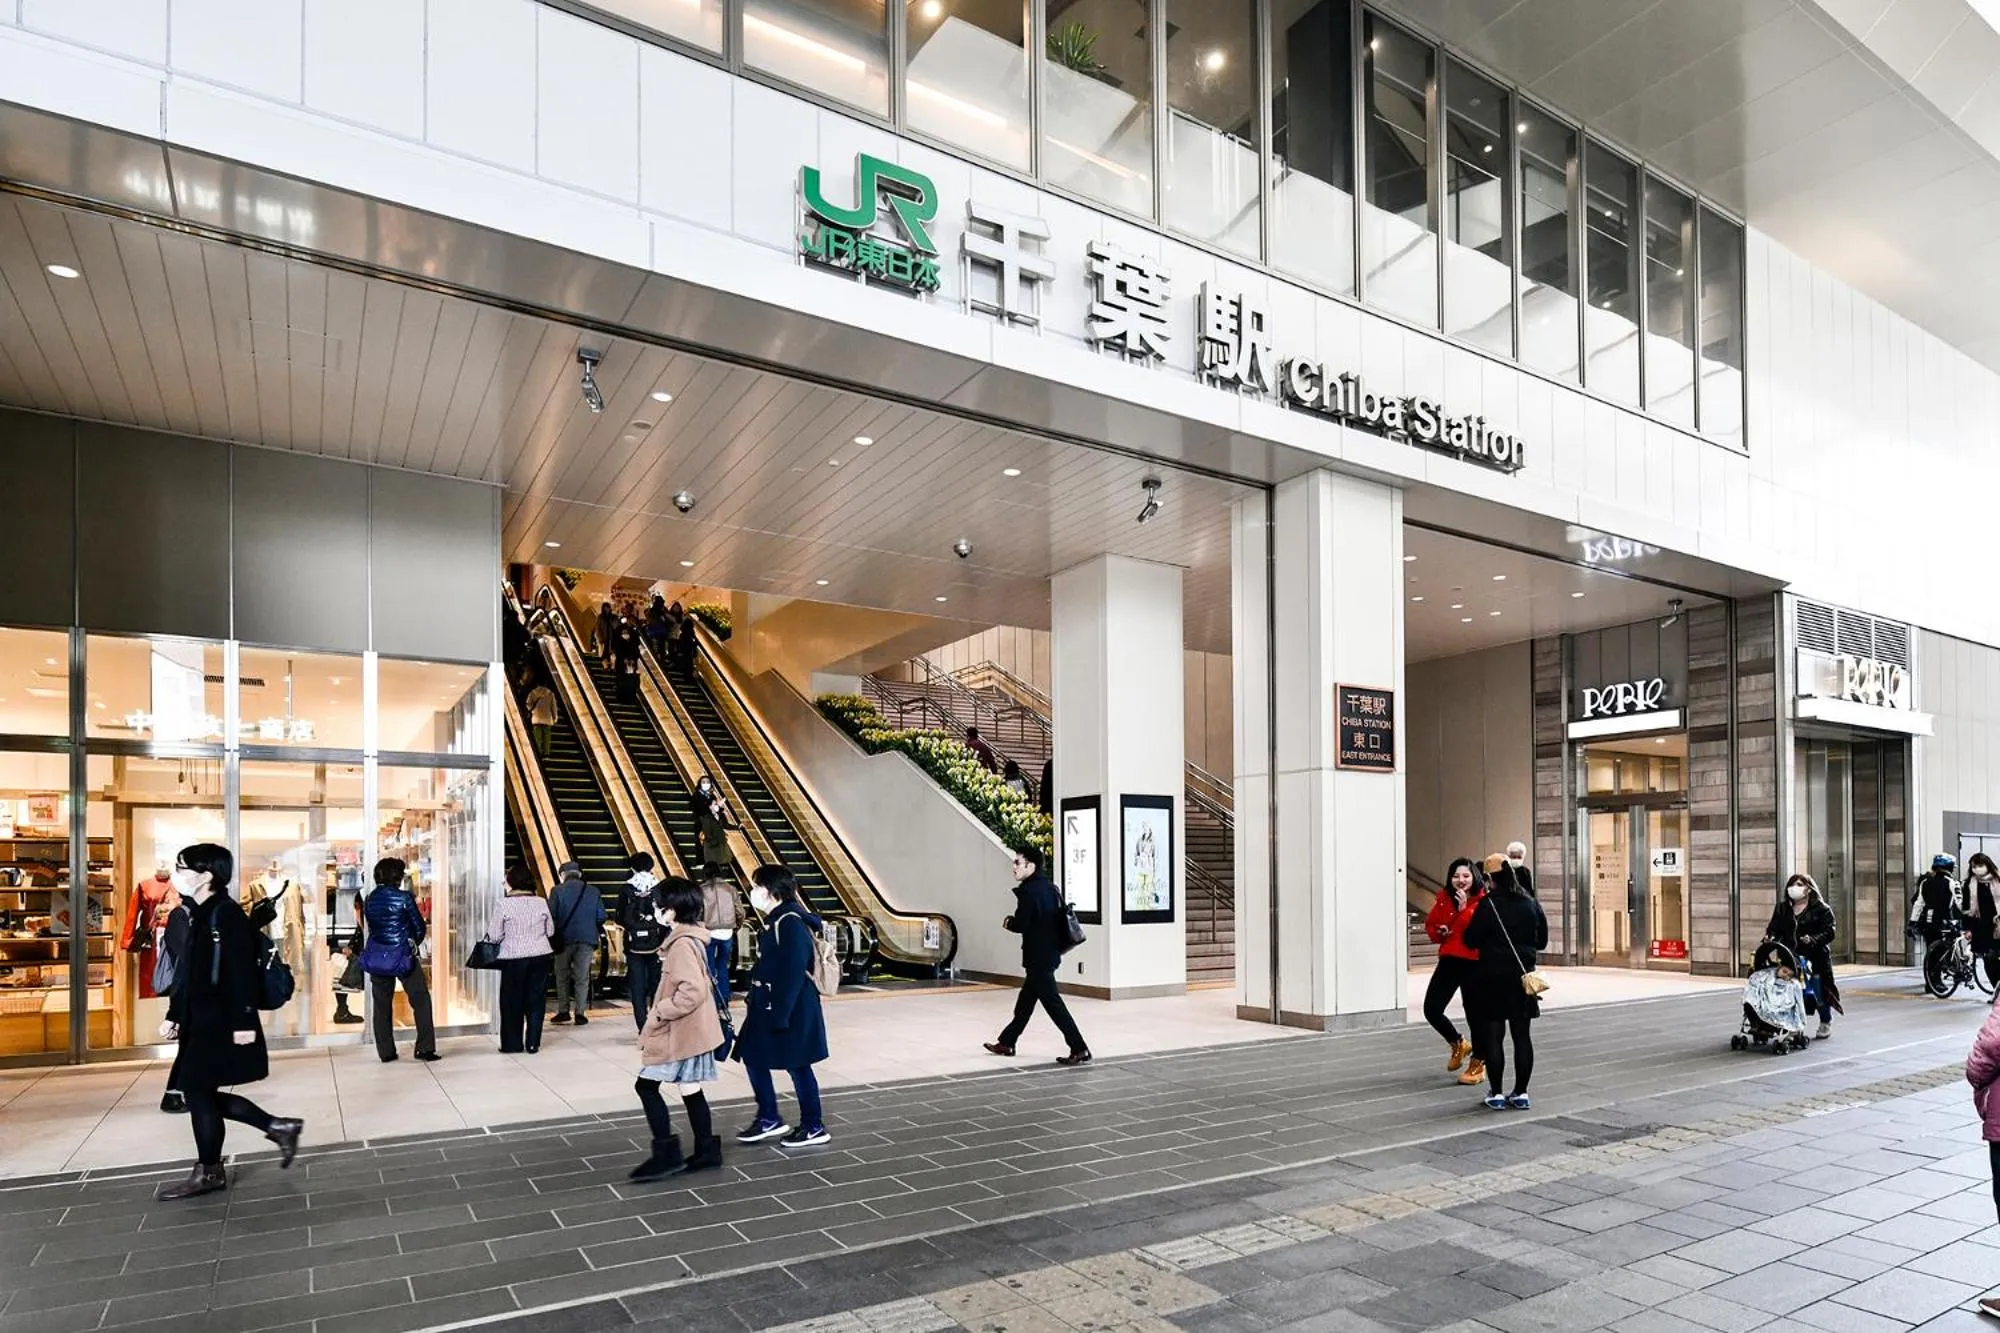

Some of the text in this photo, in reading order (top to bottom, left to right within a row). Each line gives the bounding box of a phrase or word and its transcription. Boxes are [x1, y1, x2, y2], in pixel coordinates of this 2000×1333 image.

[800, 152, 939, 254] JR
[801, 225, 942, 289] JR東日本
[1287, 352, 1406, 430] Chiba
[1410, 394, 1526, 467] Station
[1346, 694, 1386, 715] 千葉駅
[1341, 716, 1391, 730] CHIBA STATION
[1353, 731, 1380, 749] 東口
[1342, 751, 1391, 762] EAST ENTRANCE
[1072, 848, 1087, 864] 3F
